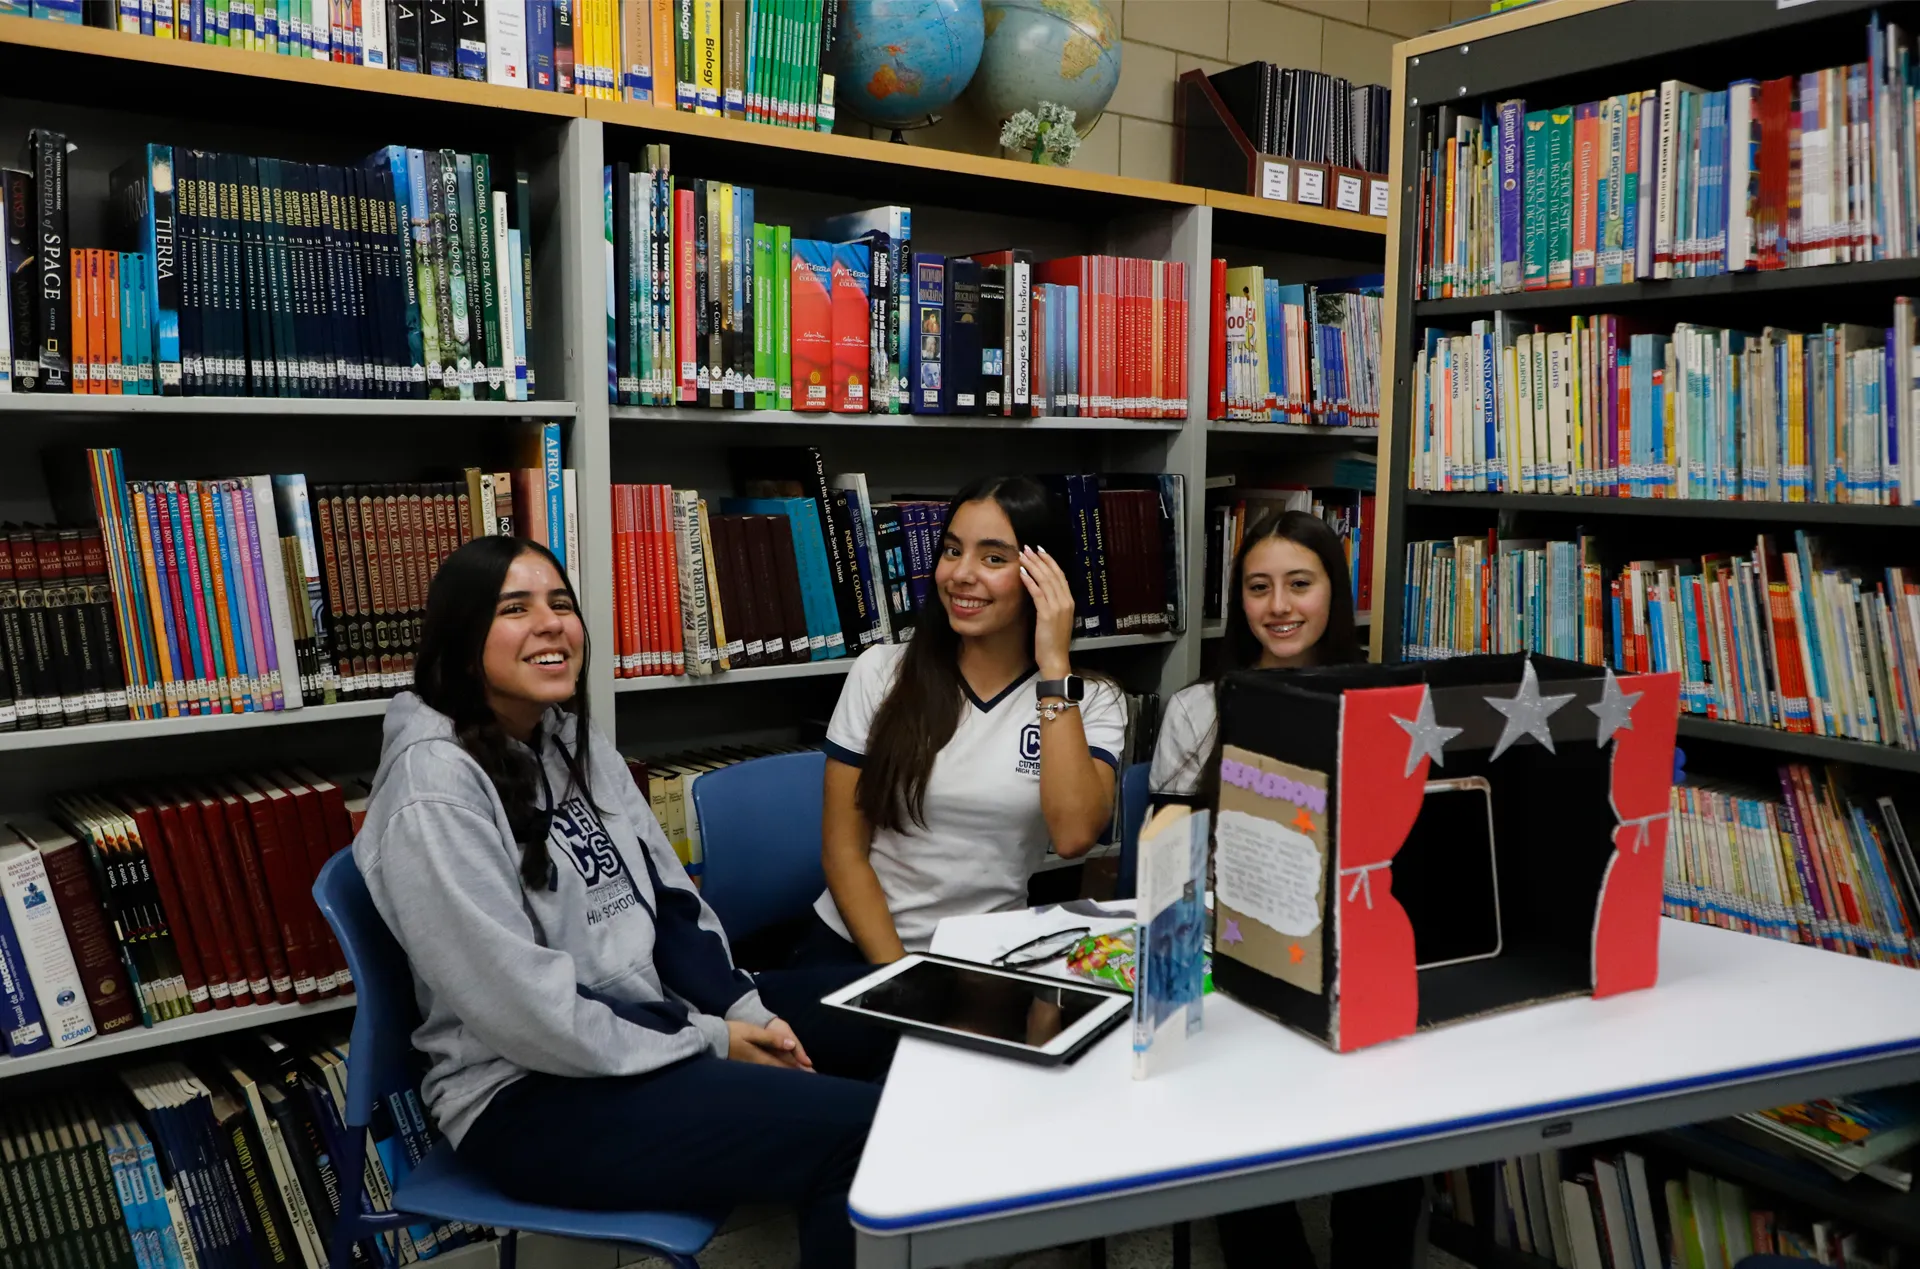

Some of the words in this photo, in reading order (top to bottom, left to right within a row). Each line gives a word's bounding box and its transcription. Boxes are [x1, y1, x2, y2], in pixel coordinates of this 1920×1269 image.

[704, 38, 715, 85] Biology
[1504, 108, 1516, 143] Harcourt
[1612, 110, 1622, 125] MY
[1611, 127, 1622, 152] FIRST
[1505, 144, 1515, 174] Science
[44, 142, 53, 219] ENCYCLOPEDIA
[179, 178, 188, 215] COUSTEAU
[188, 181, 196, 216] COUSTEAU
[199, 180, 208, 217] COUSTEAU
[445, 166, 456, 206] BOSQUE
[475, 164, 487, 215] COLOMBIA
[1560, 162, 1571, 236] SCHOLASTIC
[1609, 155, 1620, 217] DICTIONARY
[208, 182, 217, 218] COUSTEAU
[1536, 167, 1546, 241] SCHOLASTIC
[45, 220, 52, 229] of
[401, 204, 411, 248] VOLCANES
[449, 208, 458, 232] SECO
[479, 216, 490, 260] CAMINOS
[155, 217, 174, 280] TIERRA
[405, 248, 412, 260] DE
[416, 174, 425, 218] Ambientes
[424, 268, 433, 308] Colombia
[450, 233, 462, 281] TROPICAL
[44, 234, 61, 300] SPACE
[406, 261, 416, 305] COLOMBIA
[468, 226, 476, 255] ESCUDO
[474, 304, 483, 340] COLOMBIA
[481, 261, 491, 280] DEL
[651, 242, 659, 301] COLOMBIA
[891, 243, 900, 294] ALTIPLANOS
[483, 281, 493, 308] AGUA
[893, 295, 899, 308] DE
[1017, 273, 1027, 314] historia
[891, 309, 900, 356] COLOMBIA
[1017, 316, 1027, 327] la
[1021, 329, 1027, 341] de
[1016, 344, 1029, 397] Personajes
[1519, 352, 1527, 399] JOURNEYS
[1536, 351, 1545, 411] ADVENTURES
[1552, 350, 1560, 389] FLIGHTS
[1485, 375, 1494, 424] CASTLES
[546, 436, 561, 491] AFRICA
[820, 477, 825, 486] in
[158, 496, 169, 520] ARTE
[180, 496, 191, 520] ARTE
[363, 505, 374, 532] ARTE
[823, 499, 831, 515] Life
[908, 513, 912, 521] 1
[920, 512, 925, 520] 2
[169, 496, 179, 519] ARTE
[175, 525, 187, 565] 1900-1945
[687, 498, 701, 555] MUNDIAL
[844, 530, 855, 560] INDIOS
[1079, 509, 1088, 552] Antioquia
[831, 536, 840, 560] Soviet
[851, 561, 856, 573] DE
[911, 530, 921, 571] COLOMBIA
[1084, 555, 1090, 567] de
[693, 557, 705, 608] GUERRA
[835, 561, 844, 583] Union
[1085, 571, 1095, 606] Historia
[852, 574, 866, 618] COLOMBIA
[61, 1025, 92, 1042] OCEANO
[103, 1013, 133, 1030] OCEANO
